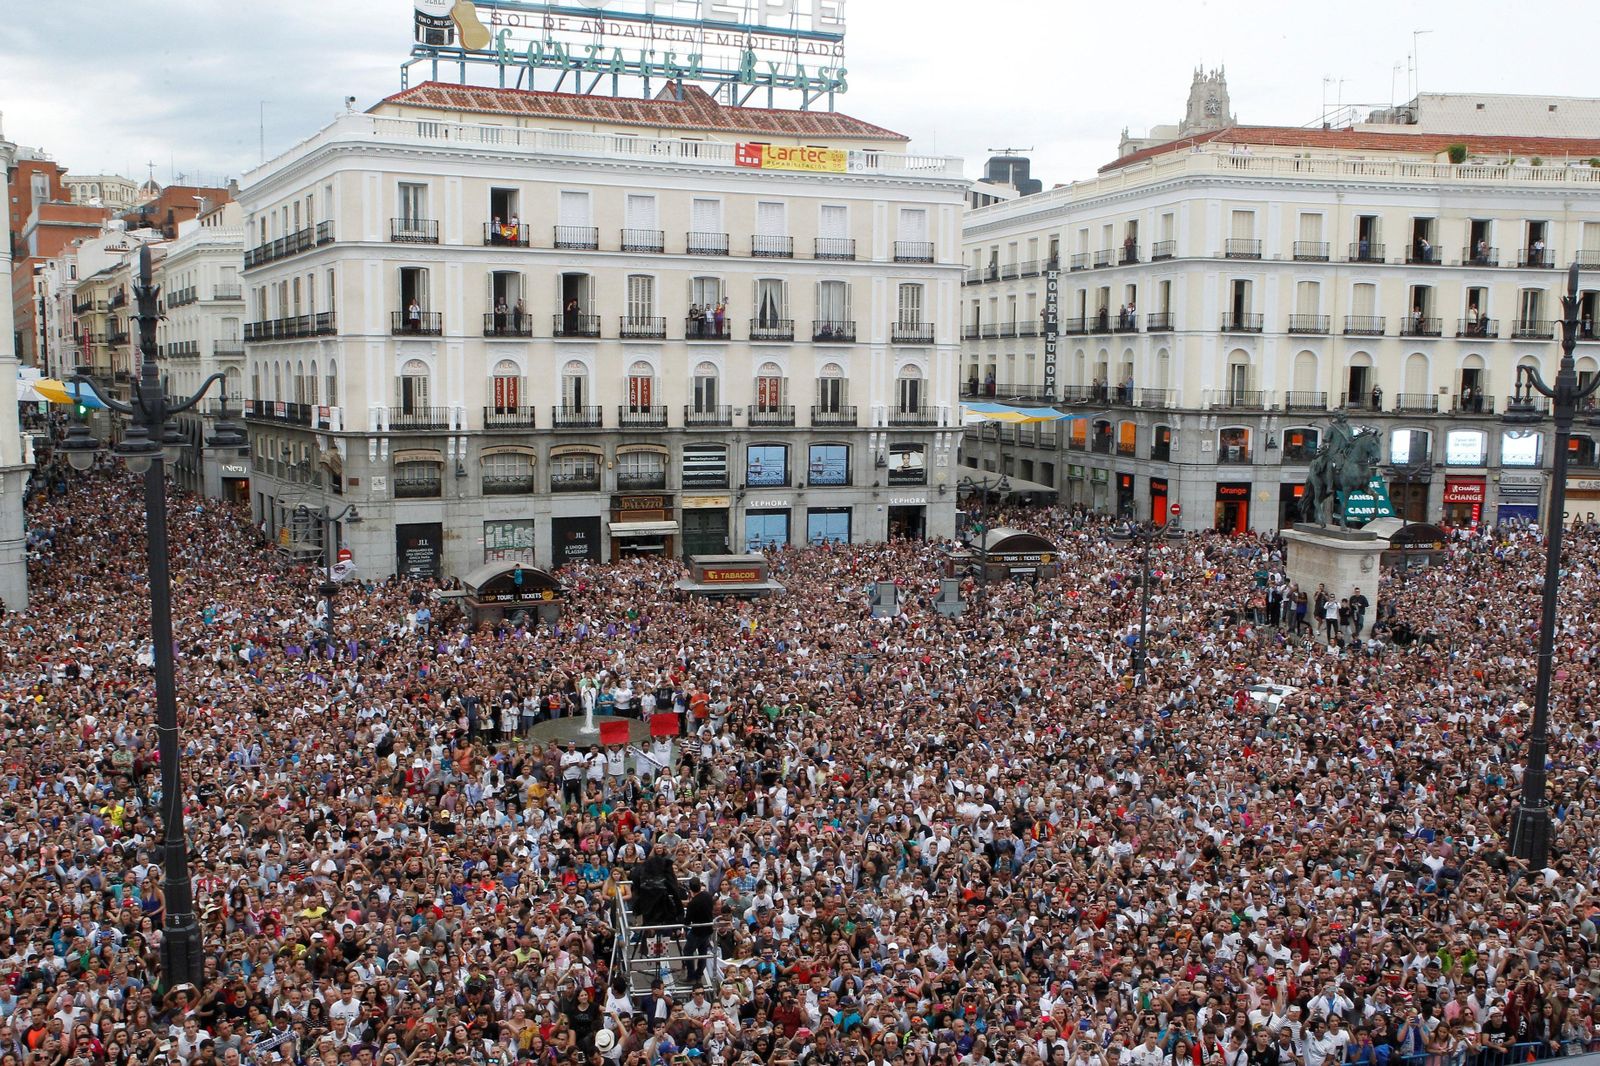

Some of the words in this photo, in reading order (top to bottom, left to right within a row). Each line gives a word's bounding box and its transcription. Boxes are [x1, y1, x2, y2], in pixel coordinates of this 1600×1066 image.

[491, 13, 531, 28] SOL
[545, 17, 571, 32] DE
[580, 20, 695, 42] ANDALUCIA
[702, 32, 845, 58] EMBOTELLADO
[496, 28, 702, 80] GONZALEZ
[740, 49, 849, 94] BYASS
[1047, 270, 1058, 325] HOTEL
[1044, 331, 1058, 398] EUROPA
[1220, 486, 1247, 495] Orange
[521, 592, 542, 600] TICKETS
